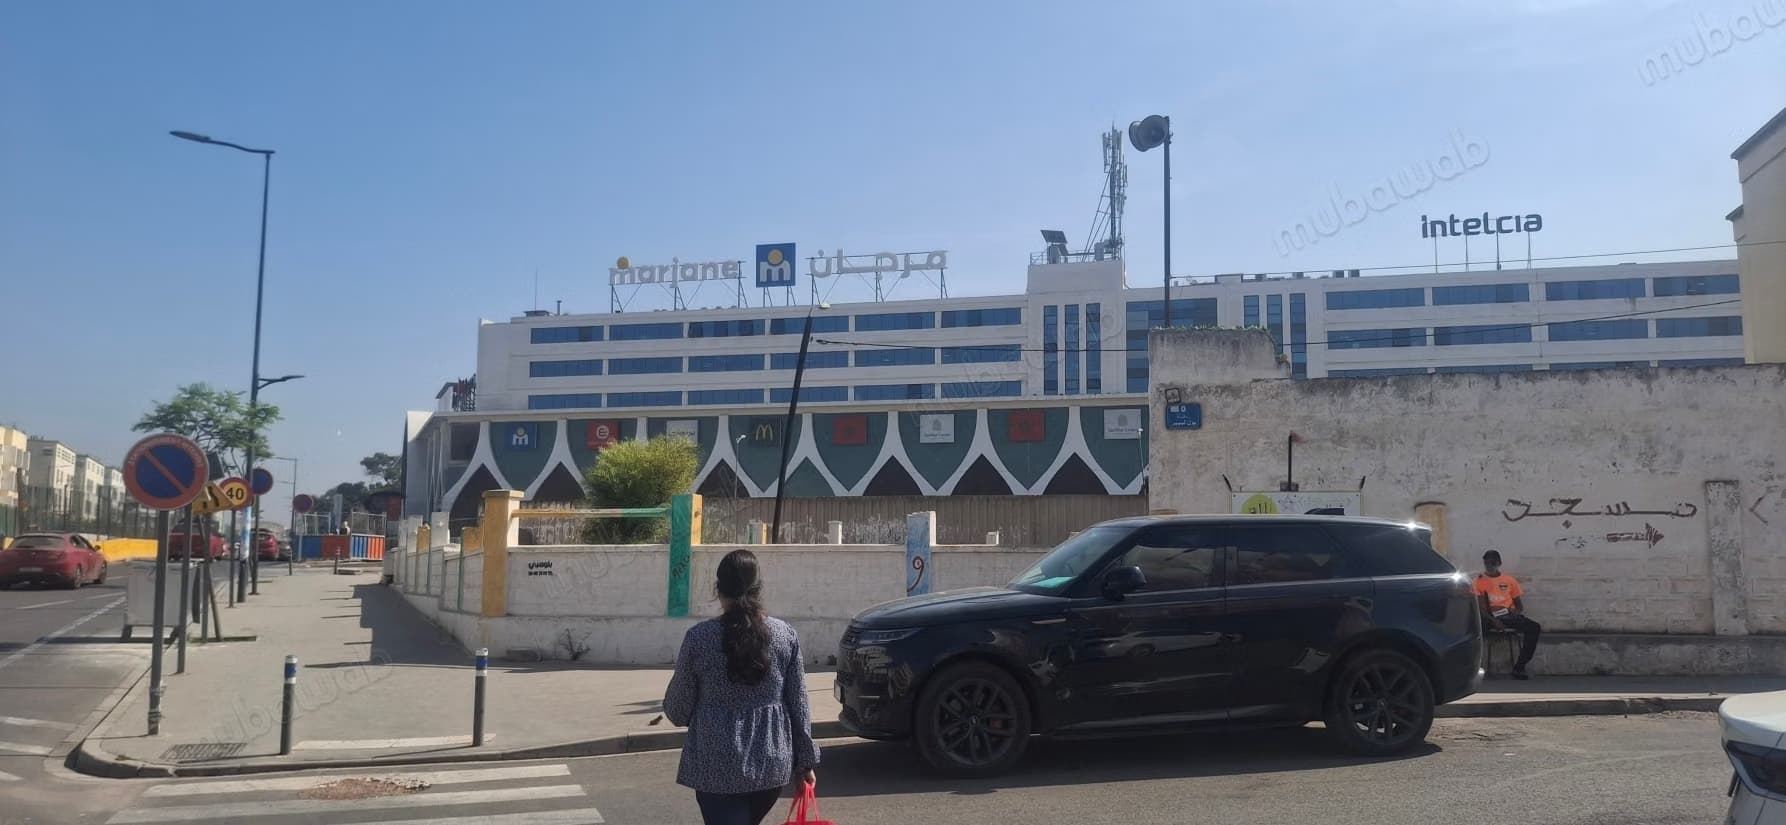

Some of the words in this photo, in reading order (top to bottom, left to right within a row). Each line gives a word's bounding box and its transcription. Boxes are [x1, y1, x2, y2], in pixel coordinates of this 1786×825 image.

[1421, 212, 1542, 238] intelcia
[608, 256, 738, 288] marjane
[809, 248, 948, 281] مرجان
[226, 487, 244, 500] 40
[1502, 498, 1698, 529] مسجد
